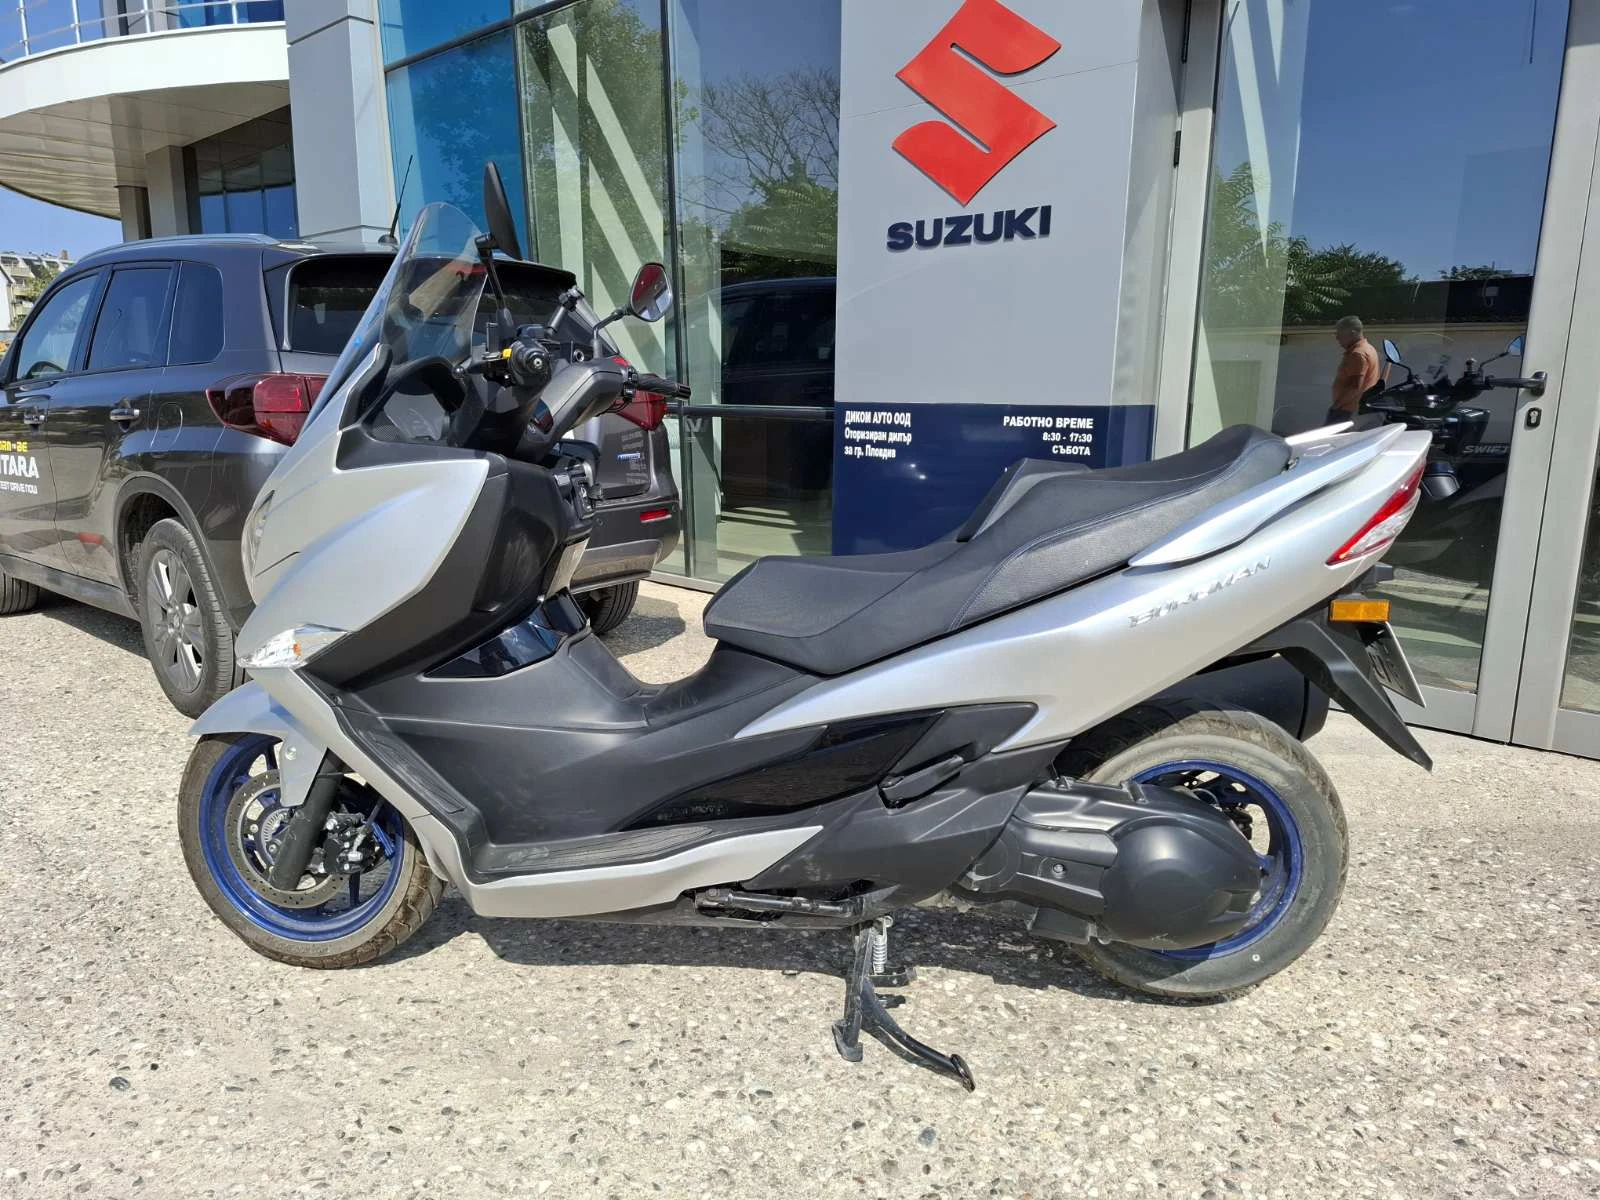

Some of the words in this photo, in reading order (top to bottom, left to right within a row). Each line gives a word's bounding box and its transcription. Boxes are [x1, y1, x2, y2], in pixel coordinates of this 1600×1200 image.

[886, 205, 1052, 252] SUZUKI
[844, 410, 872, 425] ДИКОМ
[872, 411, 893, 425] АУТО
[893, 412, 912, 428] ООД
[1003, 416, 1053, 428] РАБОТНО
[1055, 417, 1094, 429] ВРЕМЕ
[844, 426, 887, 443] Оторизиран
[1042, 431, 1061, 441] 8:30
[1069, 431, 1093, 443] 17:30
[844, 446, 853, 456] за
[865, 444, 896, 460] Пловдив
[1052, 444, 1091, 456] СЪБОТА
